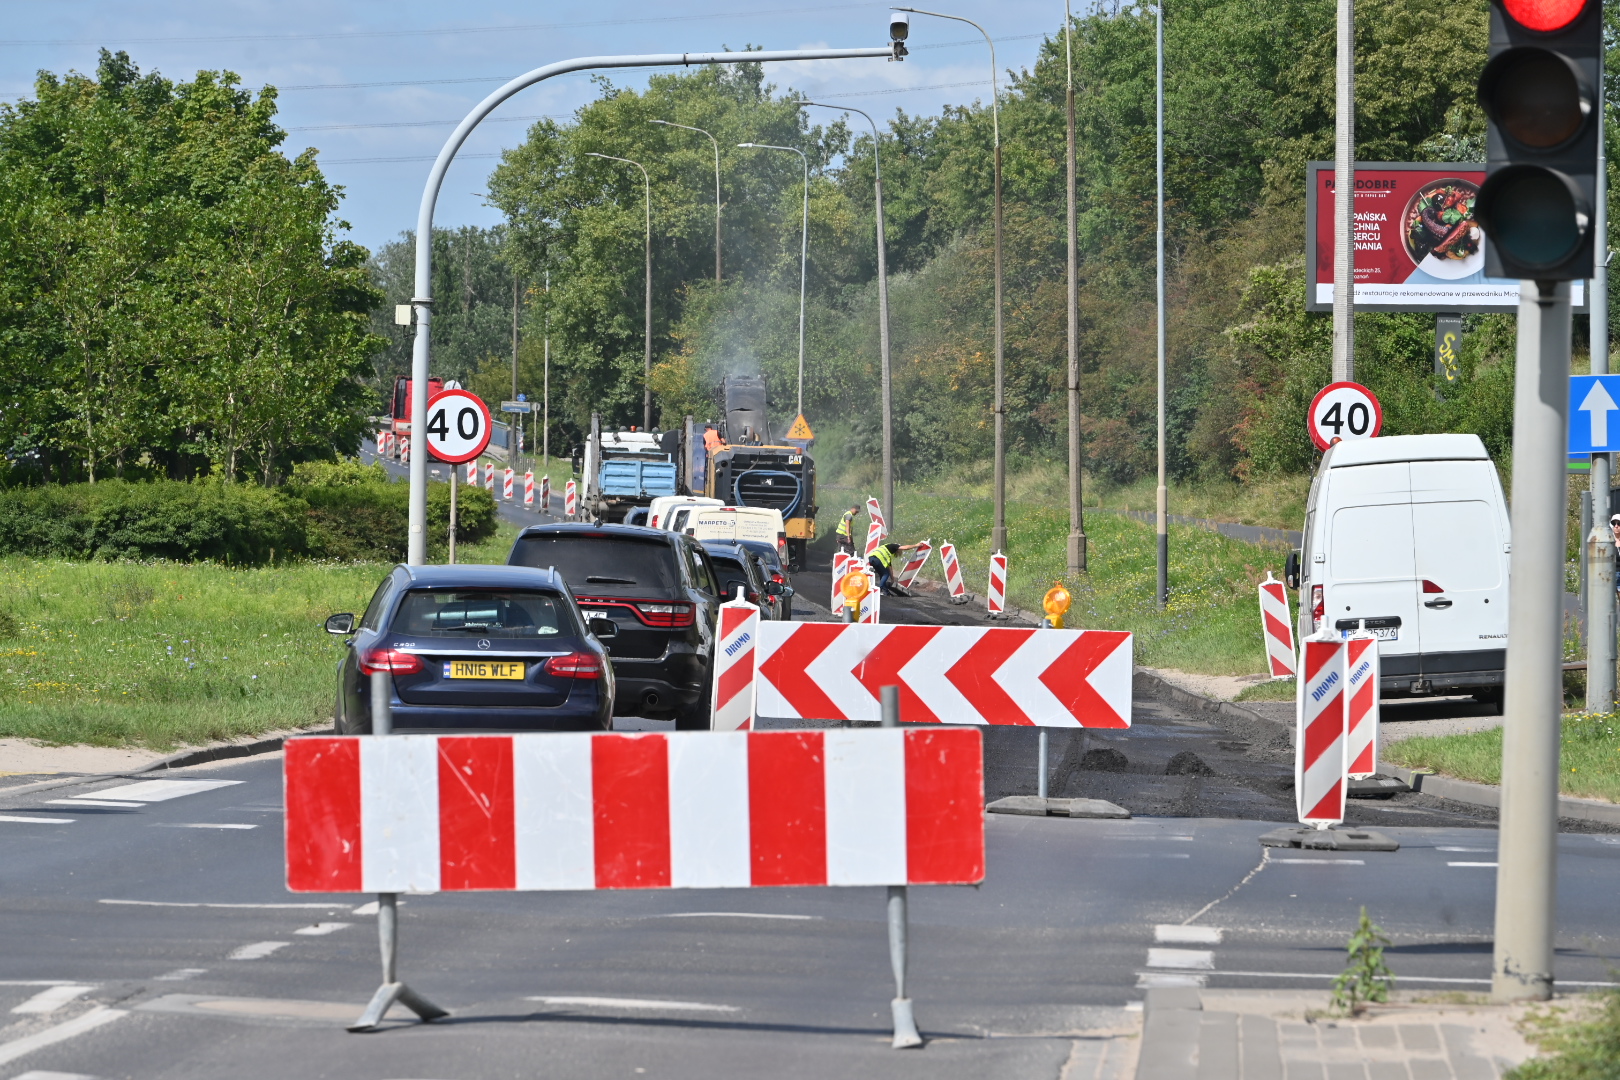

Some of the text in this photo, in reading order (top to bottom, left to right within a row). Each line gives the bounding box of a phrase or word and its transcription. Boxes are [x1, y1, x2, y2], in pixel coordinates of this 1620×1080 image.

[1325, 180, 1397, 189] PDOBRE
[1354, 211, 1387, 221] PAŃSKA
[1354, 223, 1380, 231] CHNIA
[1354, 242, 1383, 251] NANIA
[427, 407, 479, 441] 40
[1321, 402, 1369, 435] 40
[788, 455, 803, 464] CAT
[725, 632, 751, 657] DROMO
[455, 663, 518, 677] HN16 WLF
[1349, 661, 1370, 685] DROMO
[1311, 671, 1339, 702] DROMO
